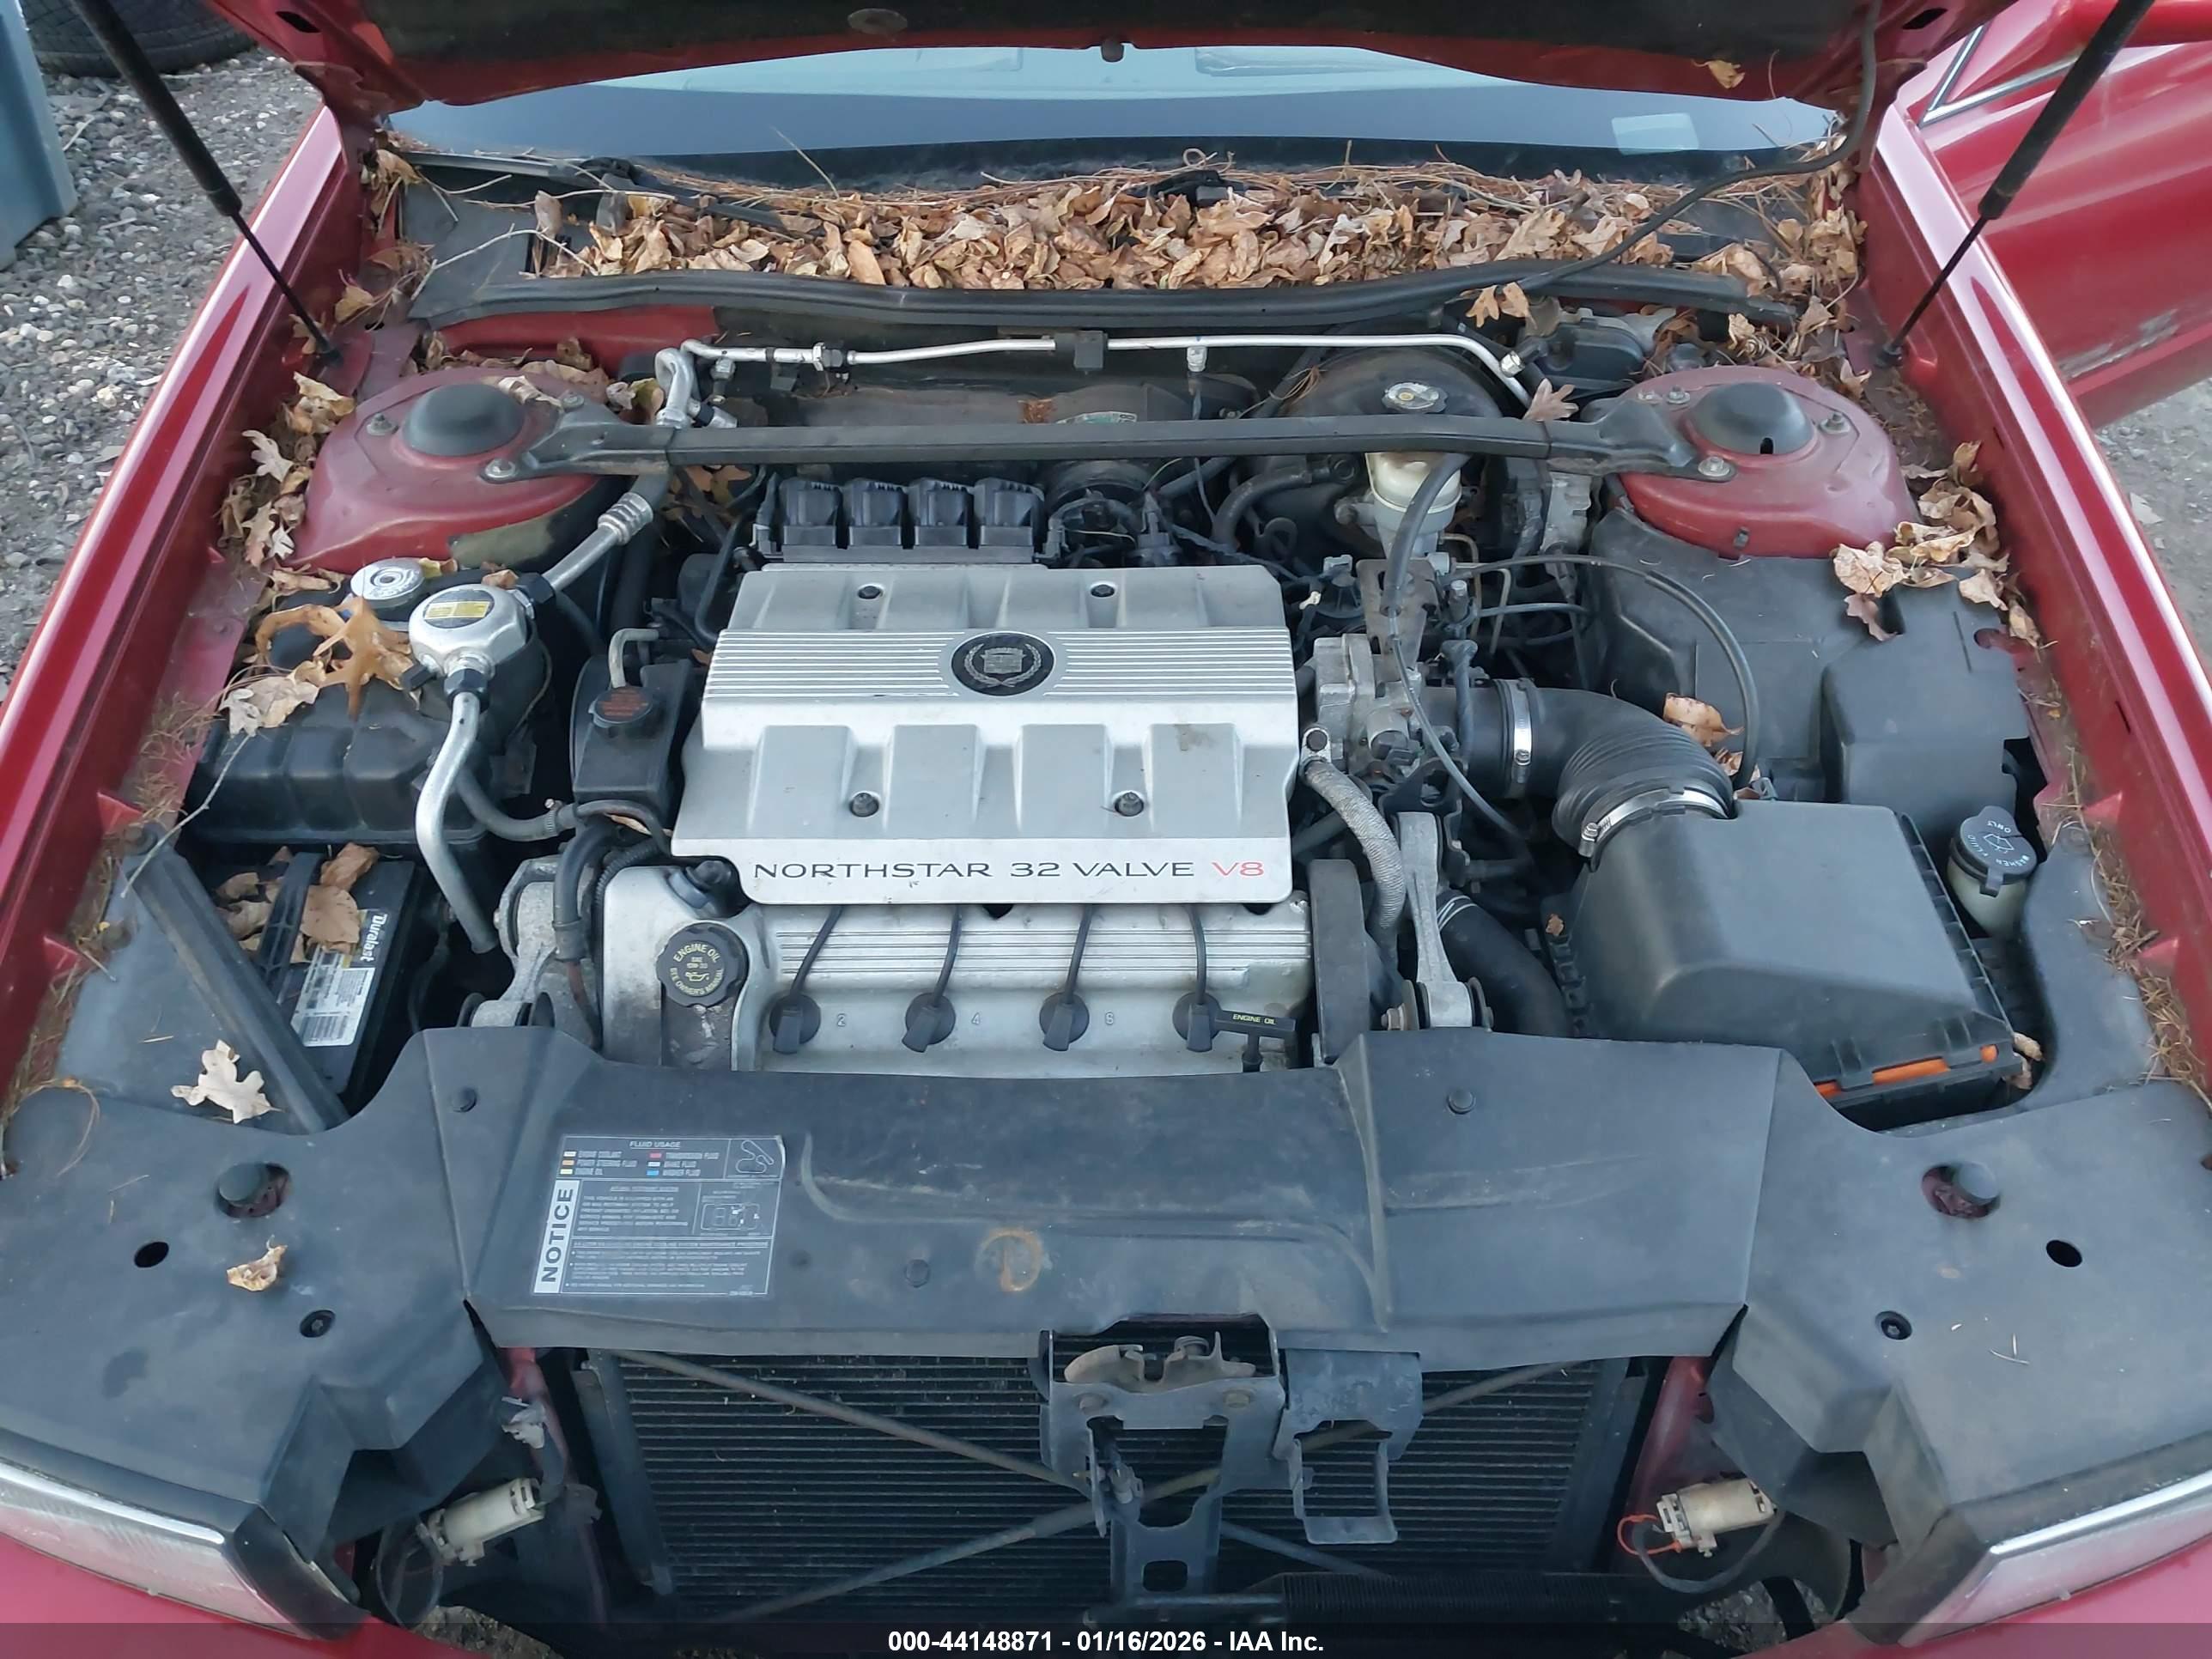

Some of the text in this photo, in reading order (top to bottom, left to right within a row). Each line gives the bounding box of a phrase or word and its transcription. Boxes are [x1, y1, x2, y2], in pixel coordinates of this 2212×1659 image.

[754, 862, 1265, 878] NORTHSTAR 32 VALVE V8
[360, 914, 388, 962] Duralast
[673, 943, 708, 963] ENGINE
[707, 948, 721, 963] OIL
[1232, 1013, 1261, 1024] ENGINE
[541, 1188, 574, 1283] NOTICE
